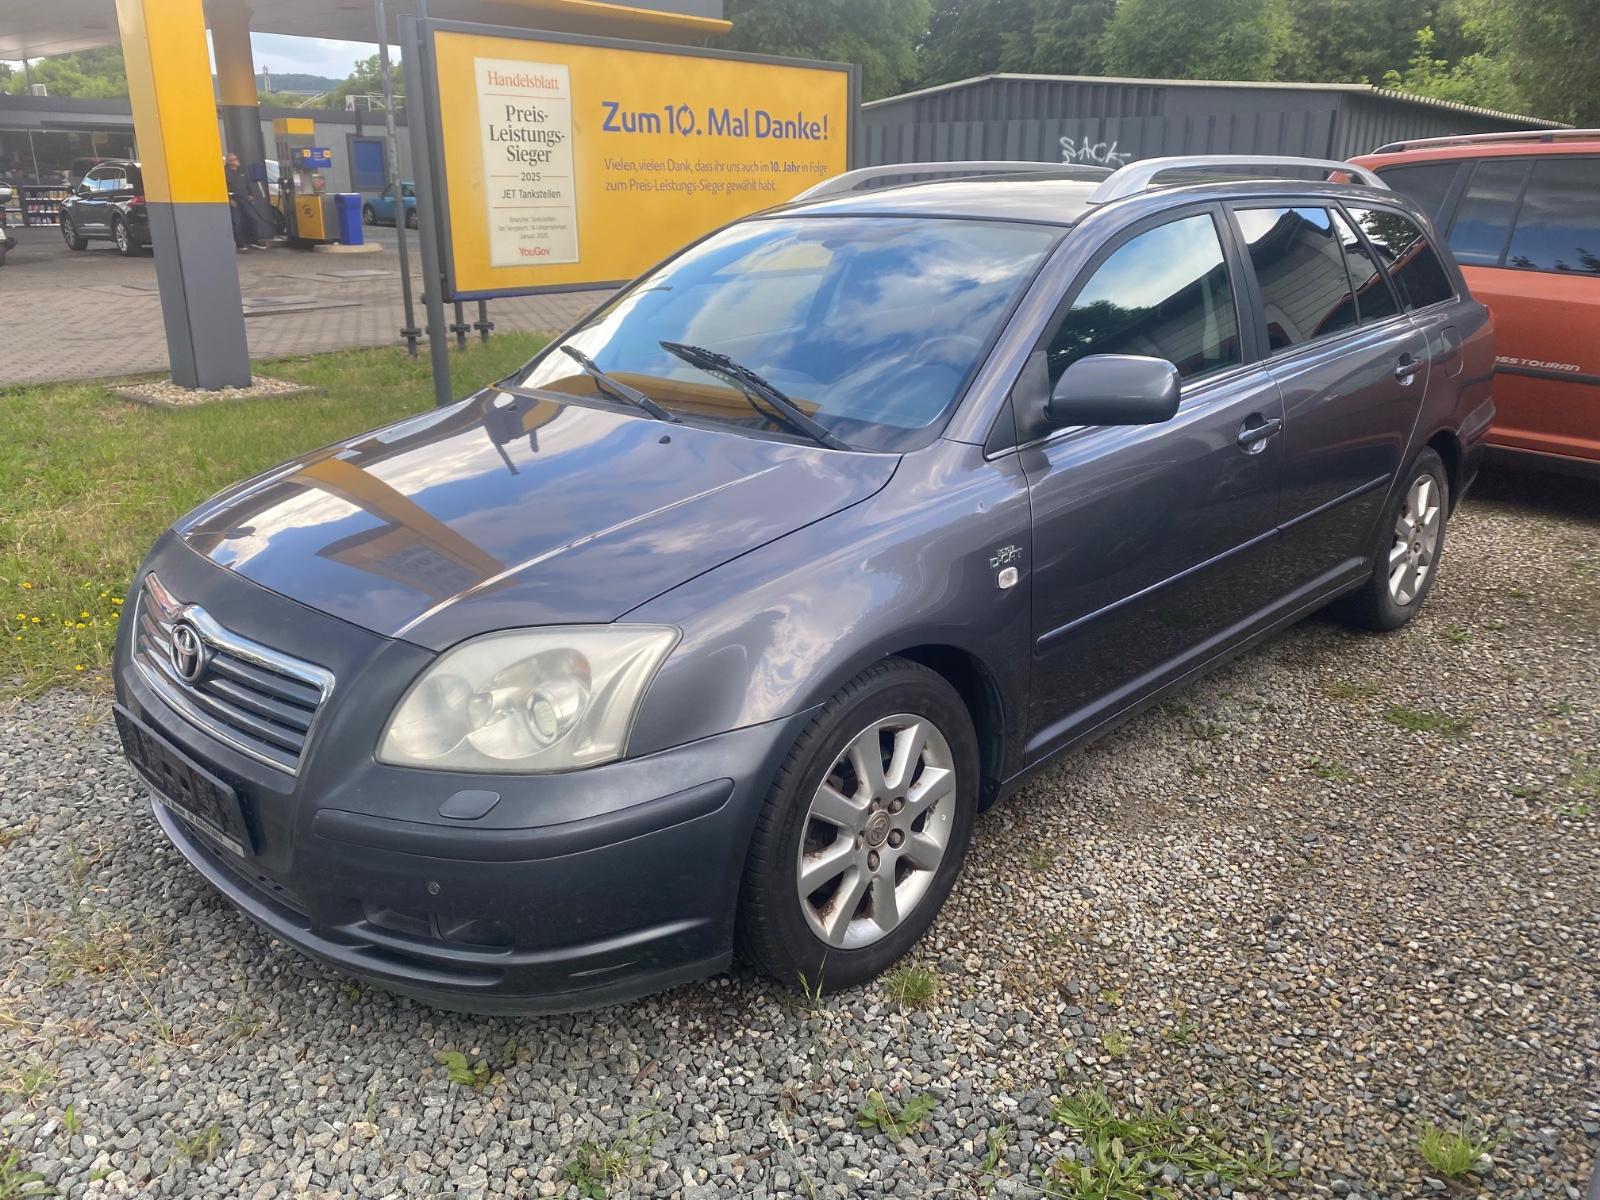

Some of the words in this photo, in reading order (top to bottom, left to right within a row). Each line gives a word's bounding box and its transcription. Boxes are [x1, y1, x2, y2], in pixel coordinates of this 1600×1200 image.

[487, 70, 560, 90] Handelsblatt
[505, 104, 549, 123] Preis-
[601, 101, 661, 134] Zum
[664, 102, 703, 137] 10.
[708, 107, 750, 137] Mal
[755, 111, 829, 140] Danke!
[489, 124, 566, 147] Leistungs-
[506, 144, 552, 167] Sieger
[1060, 136, 1131, 165] SACK
[521, 171, 542, 182] 2025
[603, 158, 639, 173] Vielen,
[639, 159, 666, 172] vielen
[667, 159, 694, 174] Dank,
[695, 160, 713, 172] dass
[714, 160, 726, 172] ihr
[727, 163, 741, 172] uns
[742, 161, 759, 173] auch
[760, 161, 770, 173] im
[770, 161, 781, 173] 10.
[782, 161, 801, 173] Jahr
[801, 162, 809, 173] in
[810, 162, 829, 177] Folge
[501, 189, 517, 199] JET
[518, 189, 562, 199] Tankstellen
[605, 181, 628, 191] zum
[629, 179, 725, 196] Preis-Leistungs-Sieger
[726, 179, 757, 196] gewählt
[519, 246, 551, 257] YouGov
[1520, 358, 1580, 372] TOURAN
